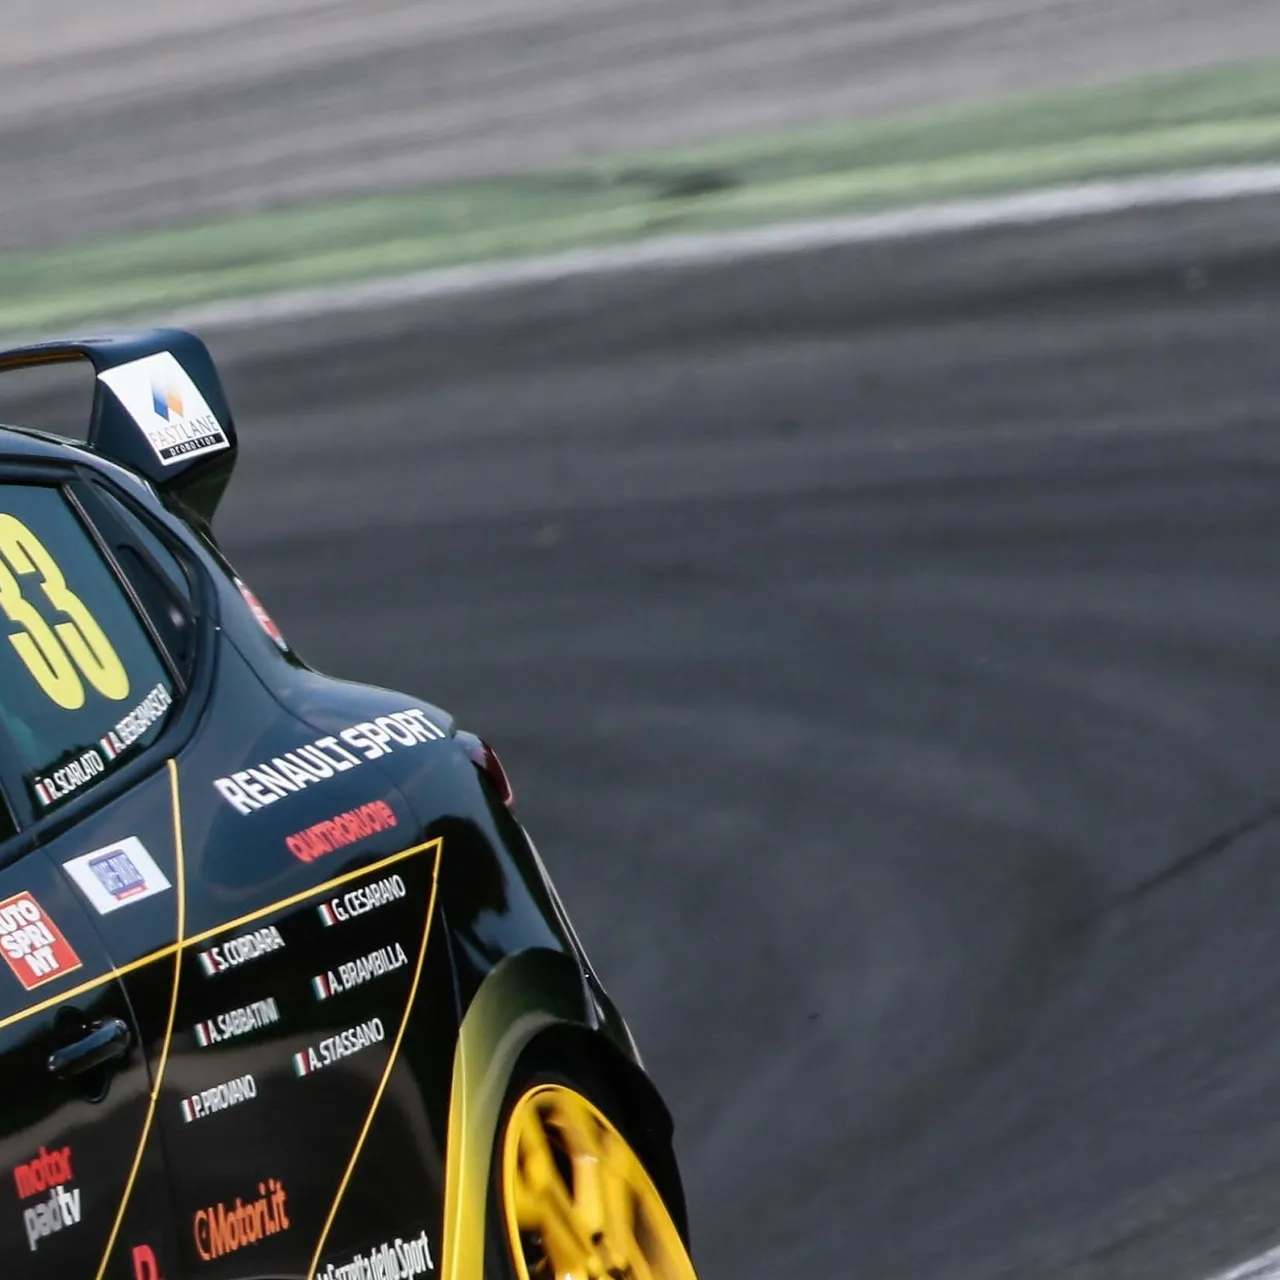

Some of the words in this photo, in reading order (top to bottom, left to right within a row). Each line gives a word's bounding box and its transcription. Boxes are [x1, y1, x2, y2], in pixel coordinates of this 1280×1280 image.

[148, 414, 220, 451] FASTLANE
[169, 435, 218, 457] promotion
[213, 735, 363, 815] RENAULT
[340, 708, 446, 760] SPORT
[343, 874, 407, 917] CESARANO
[0, 920, 56, 960] SPRI
[24, 945, 60, 978] NT
[339, 942, 409, 991] BRAMBILLA
[319, 1017, 386, 1067] STASSANO
[14, 1146, 72, 1200] motor
